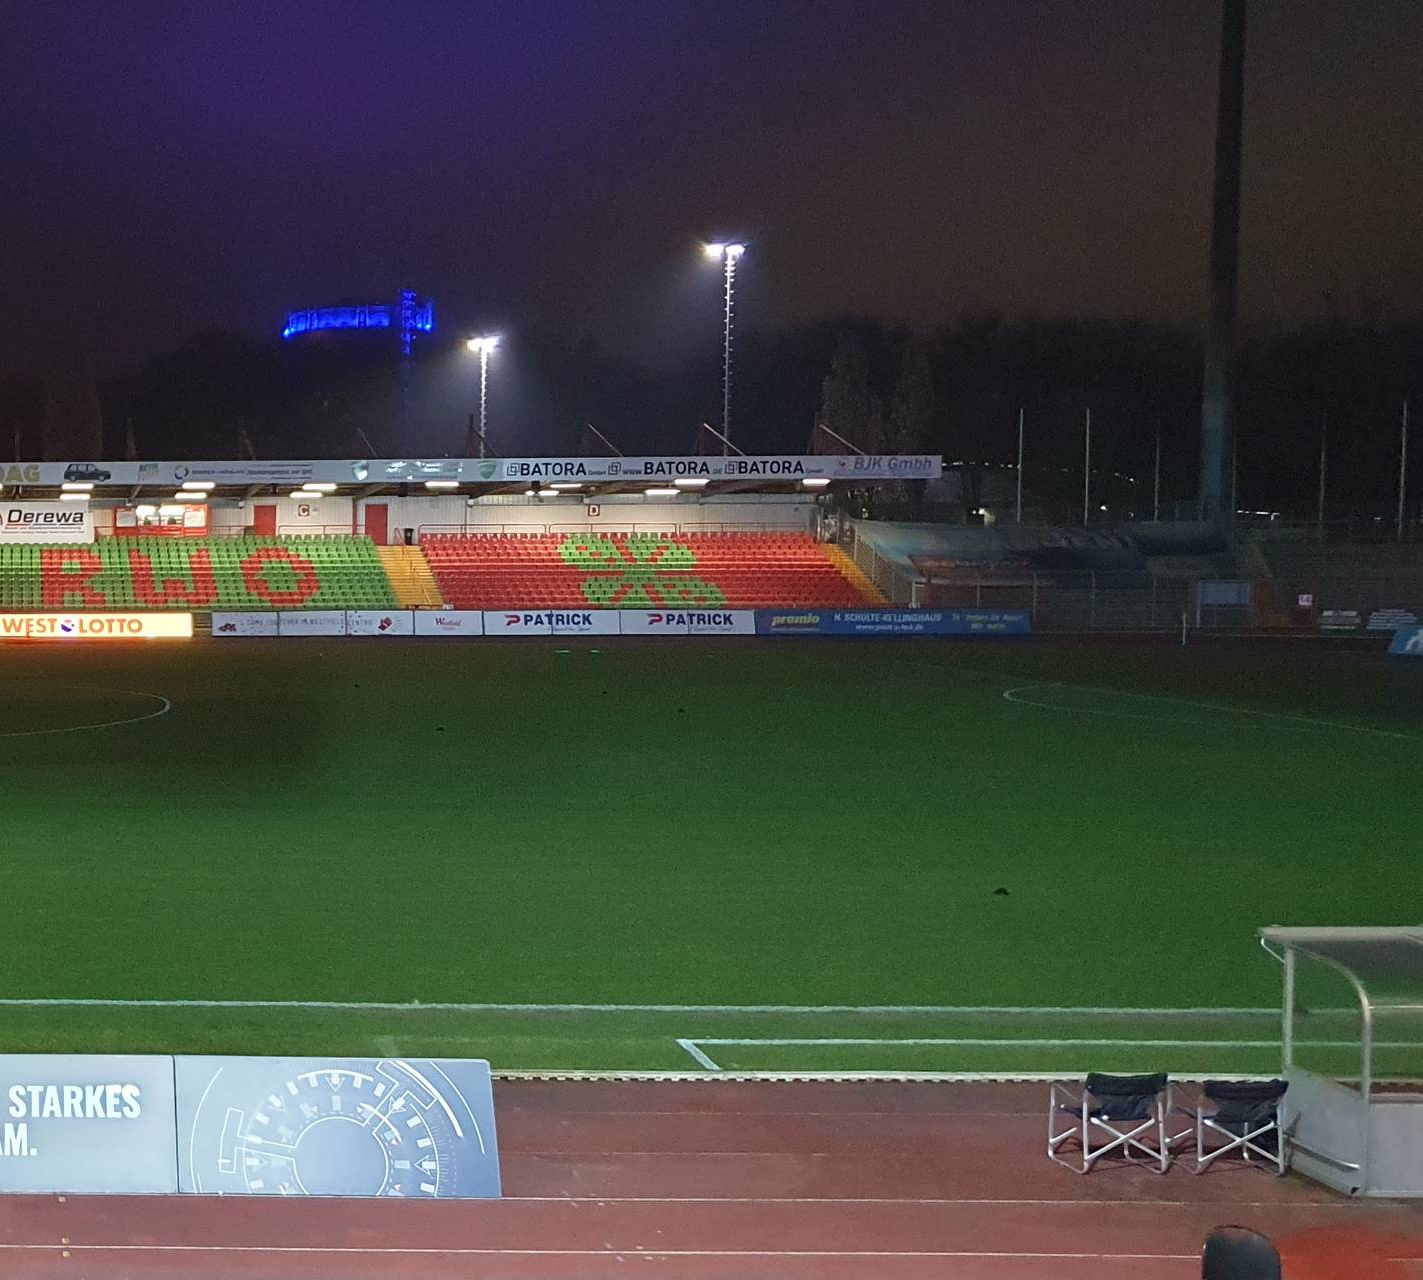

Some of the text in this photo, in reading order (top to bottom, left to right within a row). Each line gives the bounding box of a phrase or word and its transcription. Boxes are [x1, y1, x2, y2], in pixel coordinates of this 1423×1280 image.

[520, 462, 587, 476] BATORA
[644, 461, 710, 475] BATORA
[738, 461, 804, 474] BATORA
[853, 457, 883, 471] BJK
[7, 509, 84, 523] Derewa
[300, 505, 308, 516] C
[589, 504, 599, 516] D
[2, 618, 143, 633] WEST LOTTO
[524, 613, 592, 626] PATRICK
[666, 613, 733, 625] PATRICK
[771, 613, 820, 626] premio
[8, 1084, 141, 1119] STARKES
